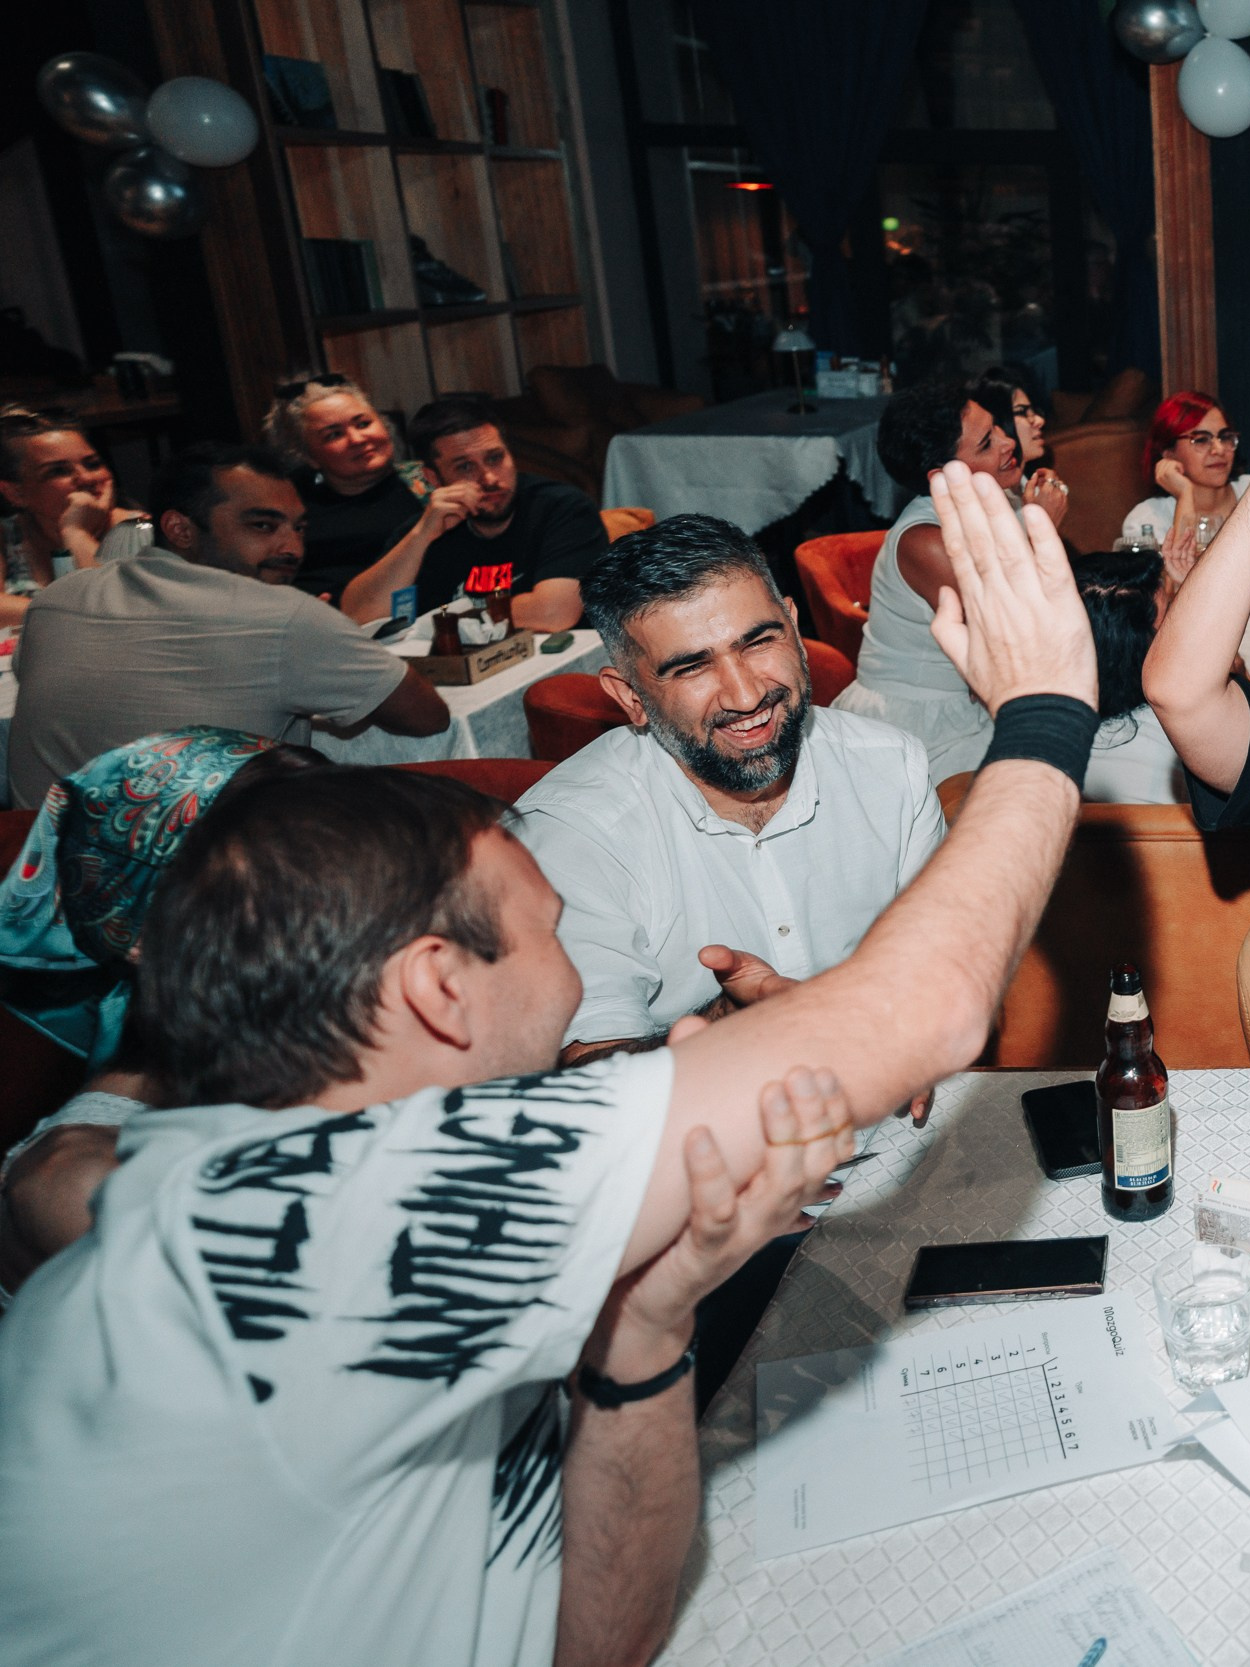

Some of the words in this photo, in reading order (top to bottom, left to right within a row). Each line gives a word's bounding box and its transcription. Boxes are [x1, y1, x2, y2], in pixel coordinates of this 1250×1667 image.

[340, 1110, 599, 1388] ANYTHING
[1009, 1350, 1019, 1358] 2
[1103, 1305, 1126, 1357] MozgoQuiz
